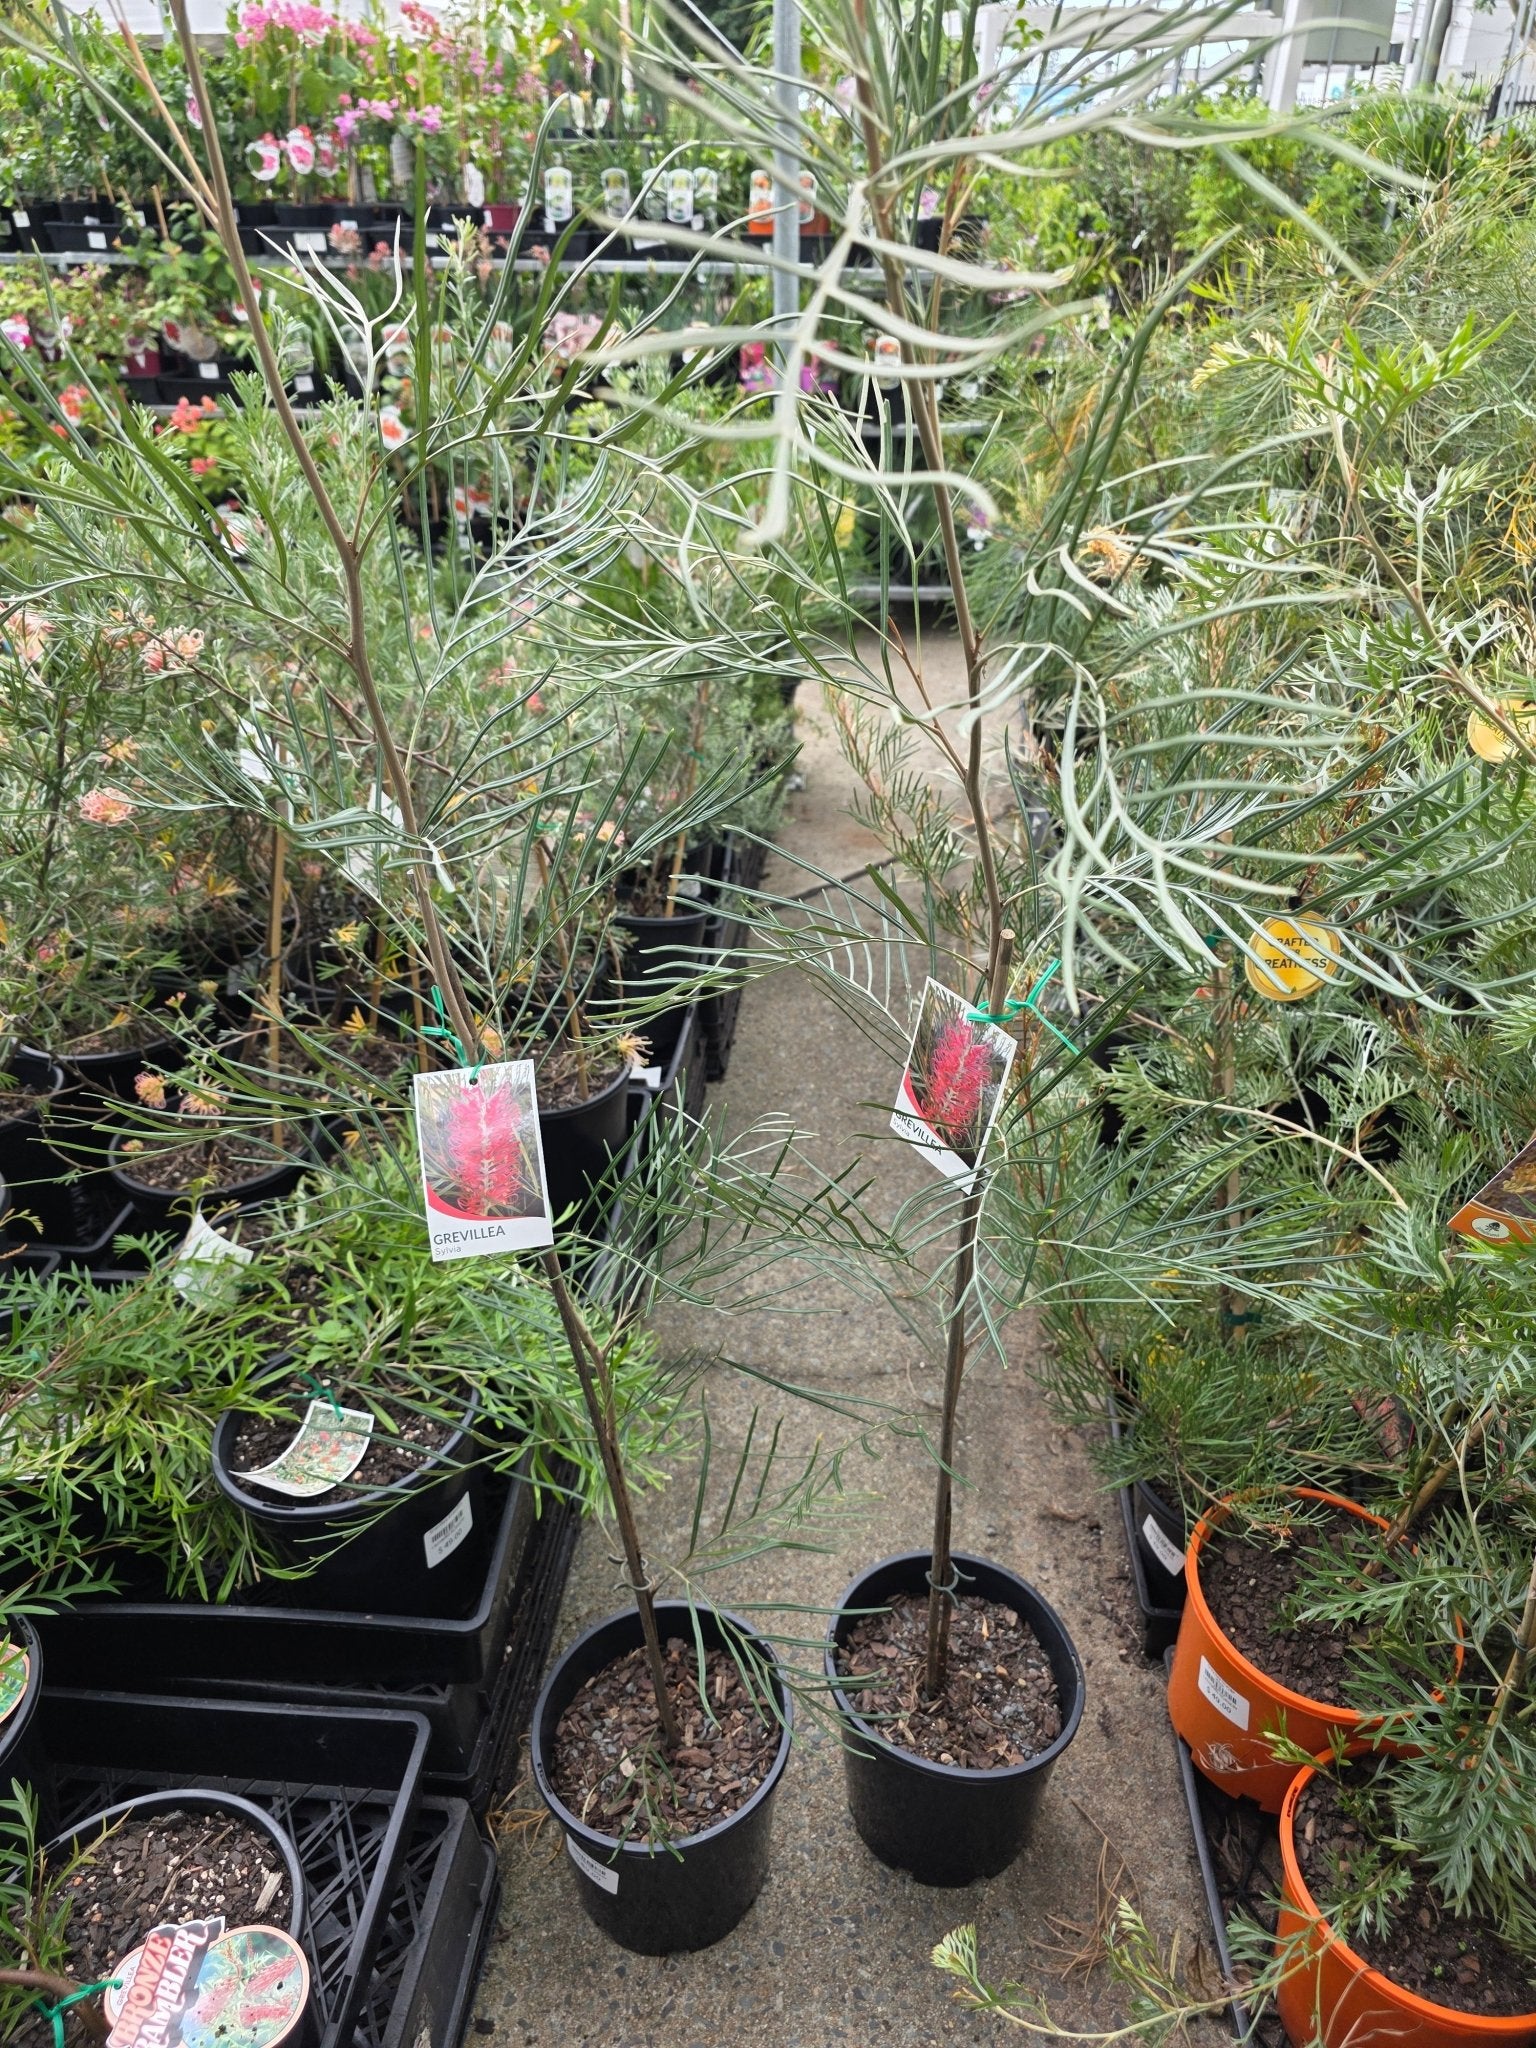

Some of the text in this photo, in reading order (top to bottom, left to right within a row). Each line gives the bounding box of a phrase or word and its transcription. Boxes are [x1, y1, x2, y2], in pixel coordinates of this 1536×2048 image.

[433, 1225, 506, 1245] GREVILLEA
[434, 1246, 462, 1256] Sylvia
[108, 1932, 173, 2047] BRONZE
